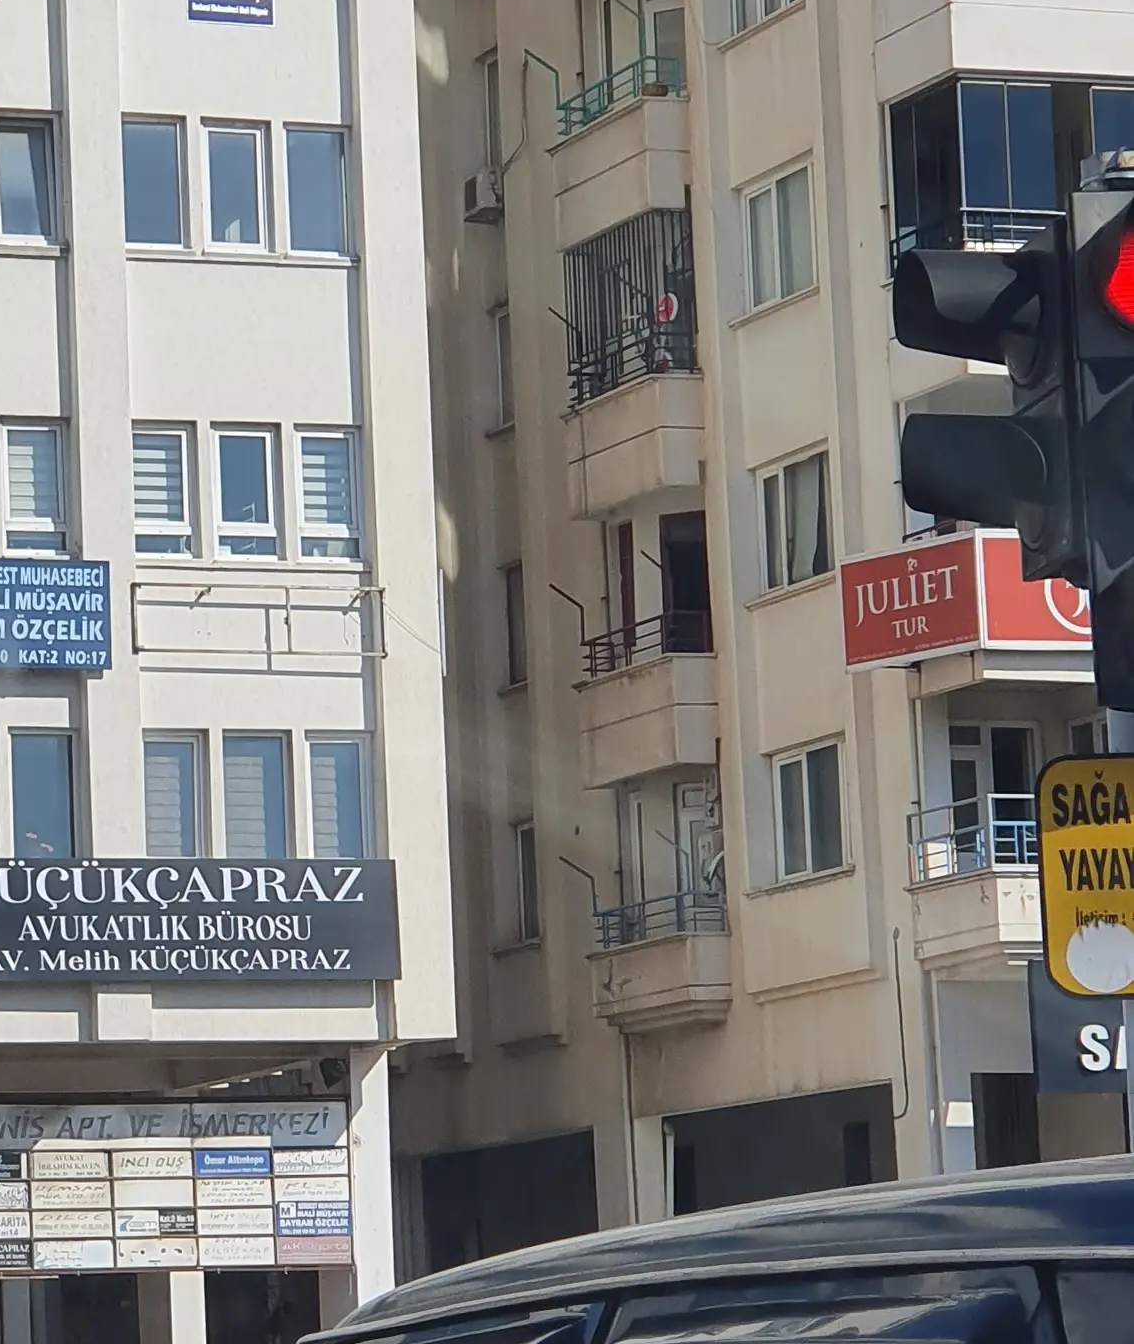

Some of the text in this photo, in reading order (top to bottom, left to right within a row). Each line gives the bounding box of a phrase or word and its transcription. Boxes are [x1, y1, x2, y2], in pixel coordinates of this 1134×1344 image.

[20, 565, 104, 587] MUHASEBECİ
[15, 588, 104, 614] MÜŞAVİR
[12, 614, 105, 645] ÖZÇELİK
[891, 615, 930, 639] TUR
[18, 649, 59, 665] KAT:2
[65, 651, 107, 666] NO:17
[1051, 769, 1132, 827] SAĞA
[17, 909, 313, 943] AVUKATLIK BÜROSU
[39, 948, 122, 972] Melih
[129, 944, 352, 976] KÜÇÜKÇAPRAZ
[129, 1113, 164, 1138] VE
